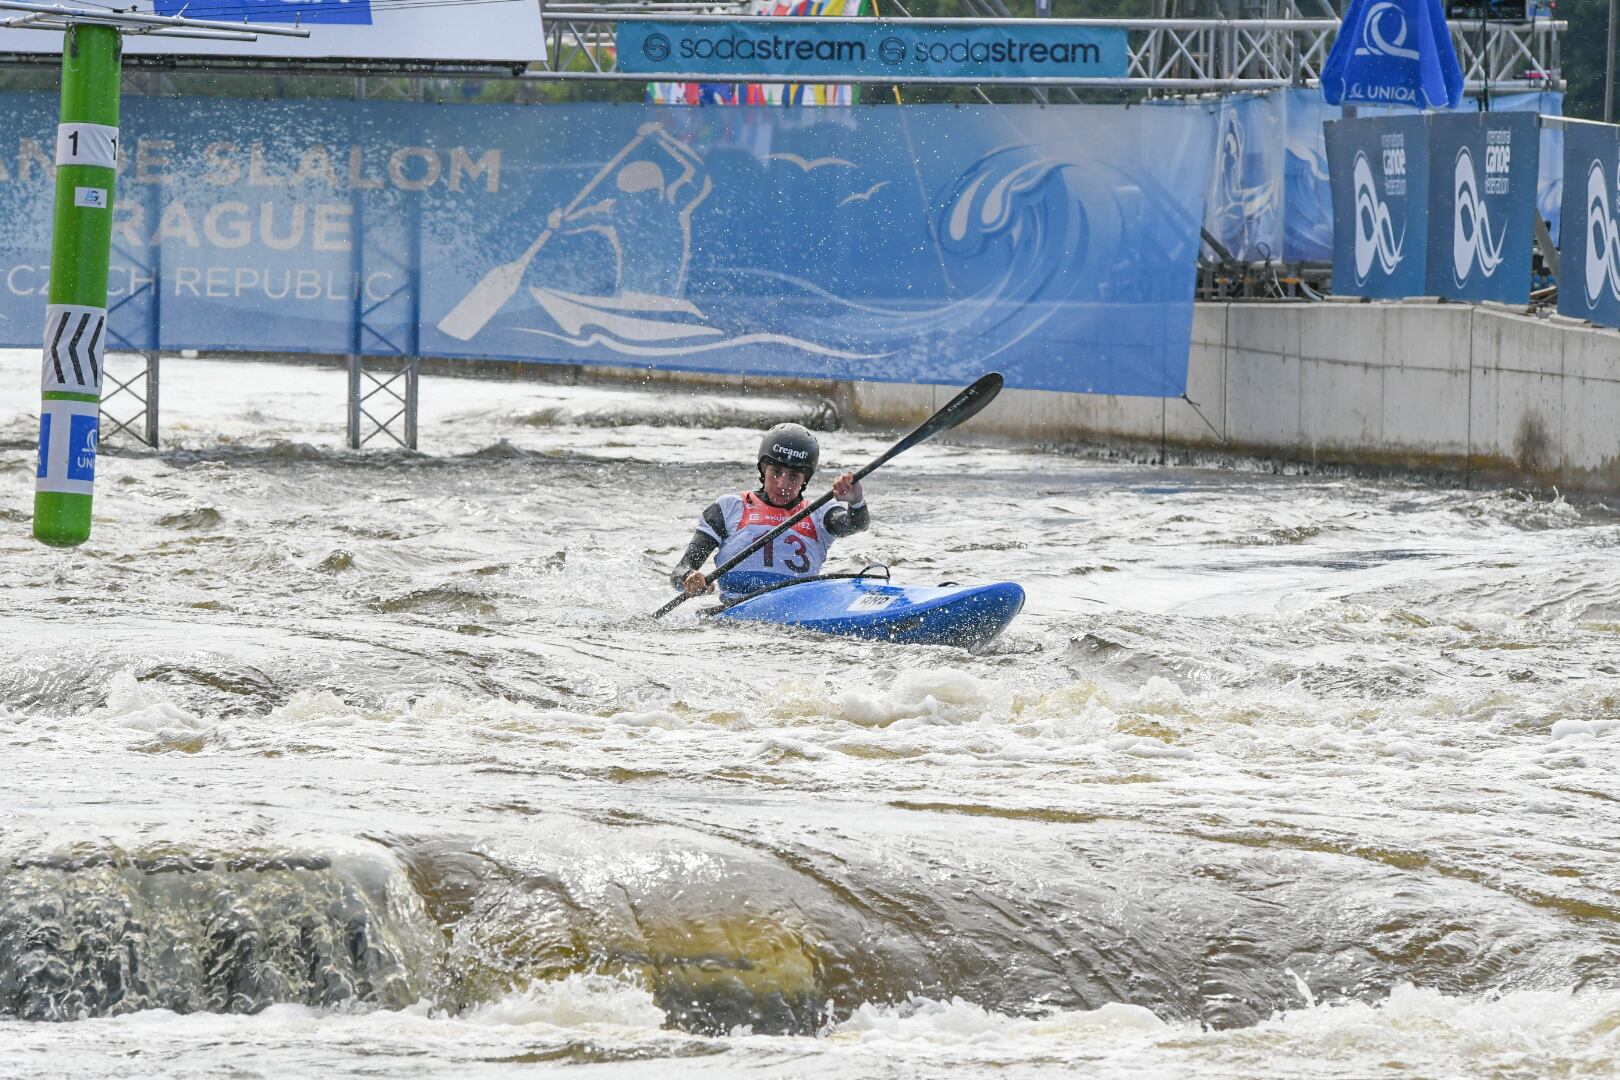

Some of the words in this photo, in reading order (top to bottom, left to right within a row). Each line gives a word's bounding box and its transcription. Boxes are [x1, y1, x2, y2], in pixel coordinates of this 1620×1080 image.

[680, 34, 866, 61] sodastream
[915, 38, 1100, 63] sodastream
[1367, 84, 1416, 102] UNIQA
[68, 130, 78, 156] 1
[203, 141, 502, 193] SLALOM
[112, 198, 353, 251] RAGUE
[175, 267, 393, 301] REPUBLIC
[753, 530, 811, 573] 13
